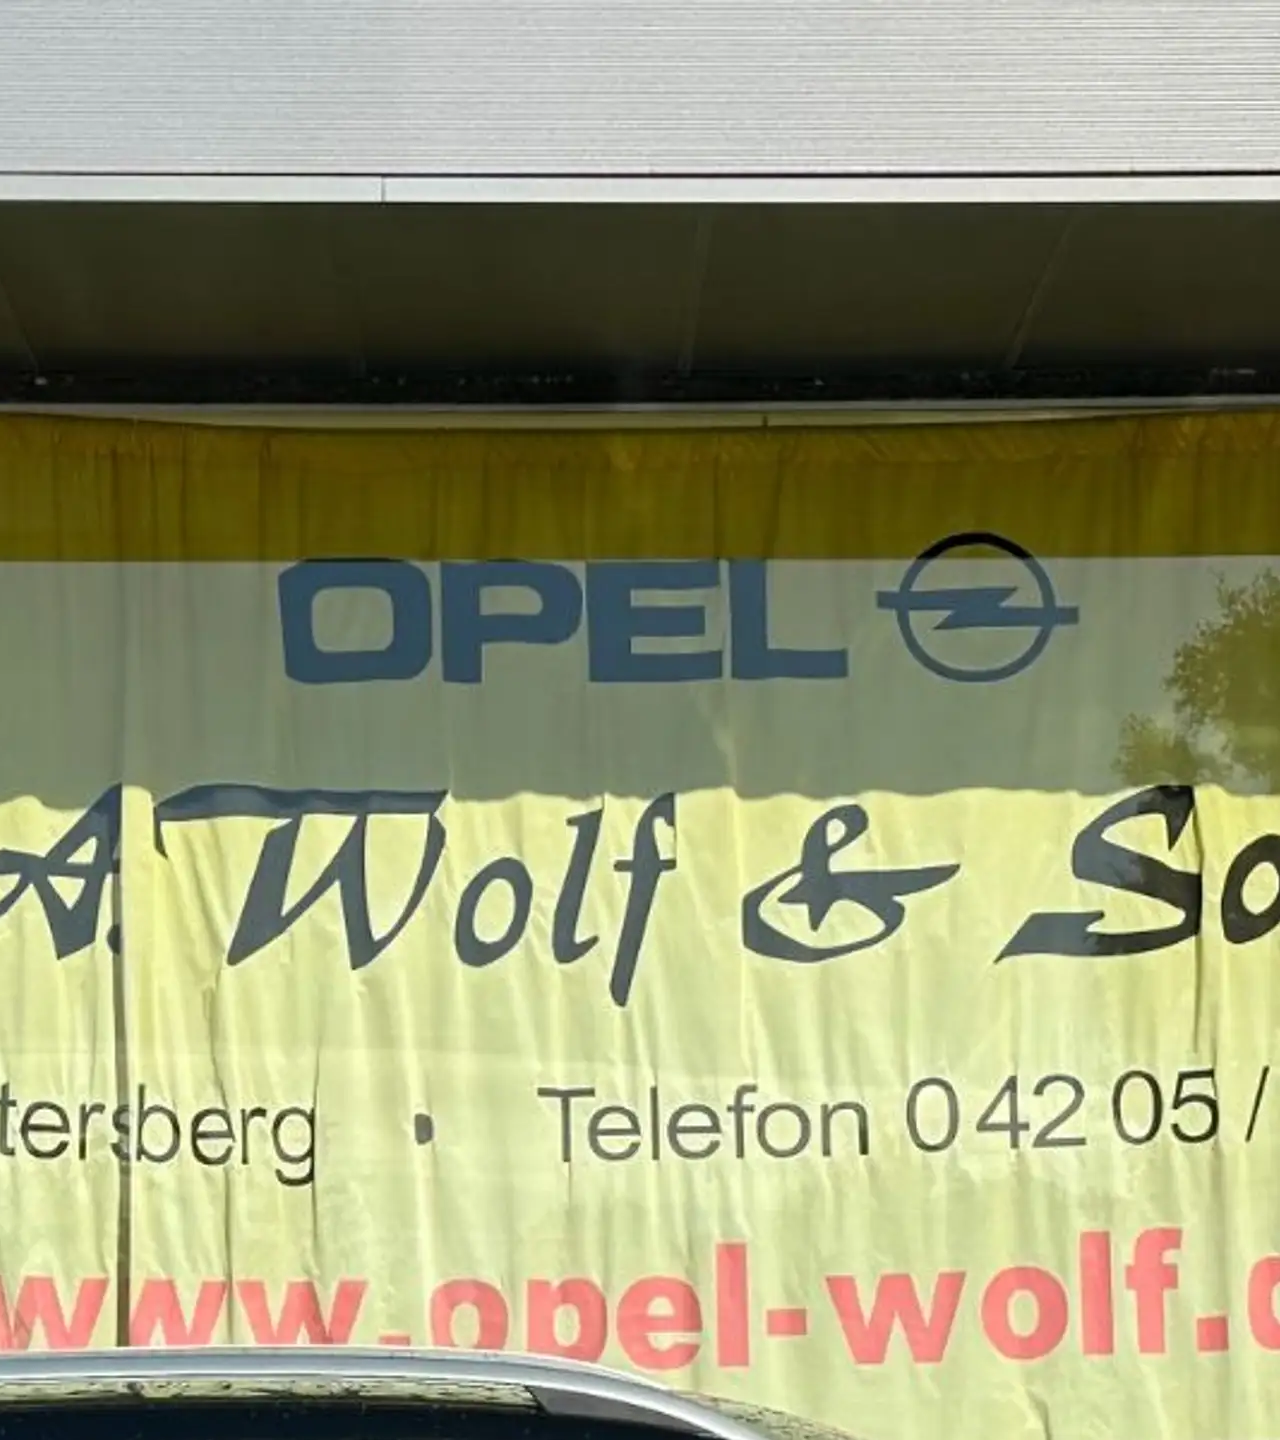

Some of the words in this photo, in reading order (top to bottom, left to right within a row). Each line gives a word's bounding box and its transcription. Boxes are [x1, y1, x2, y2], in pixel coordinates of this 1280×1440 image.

[277, 558, 849, 685] OPEL
[153, 783, 678, 1007] Wolf
[742, 804, 961, 963] &
[537, 1084, 870, 1163] Telefon
